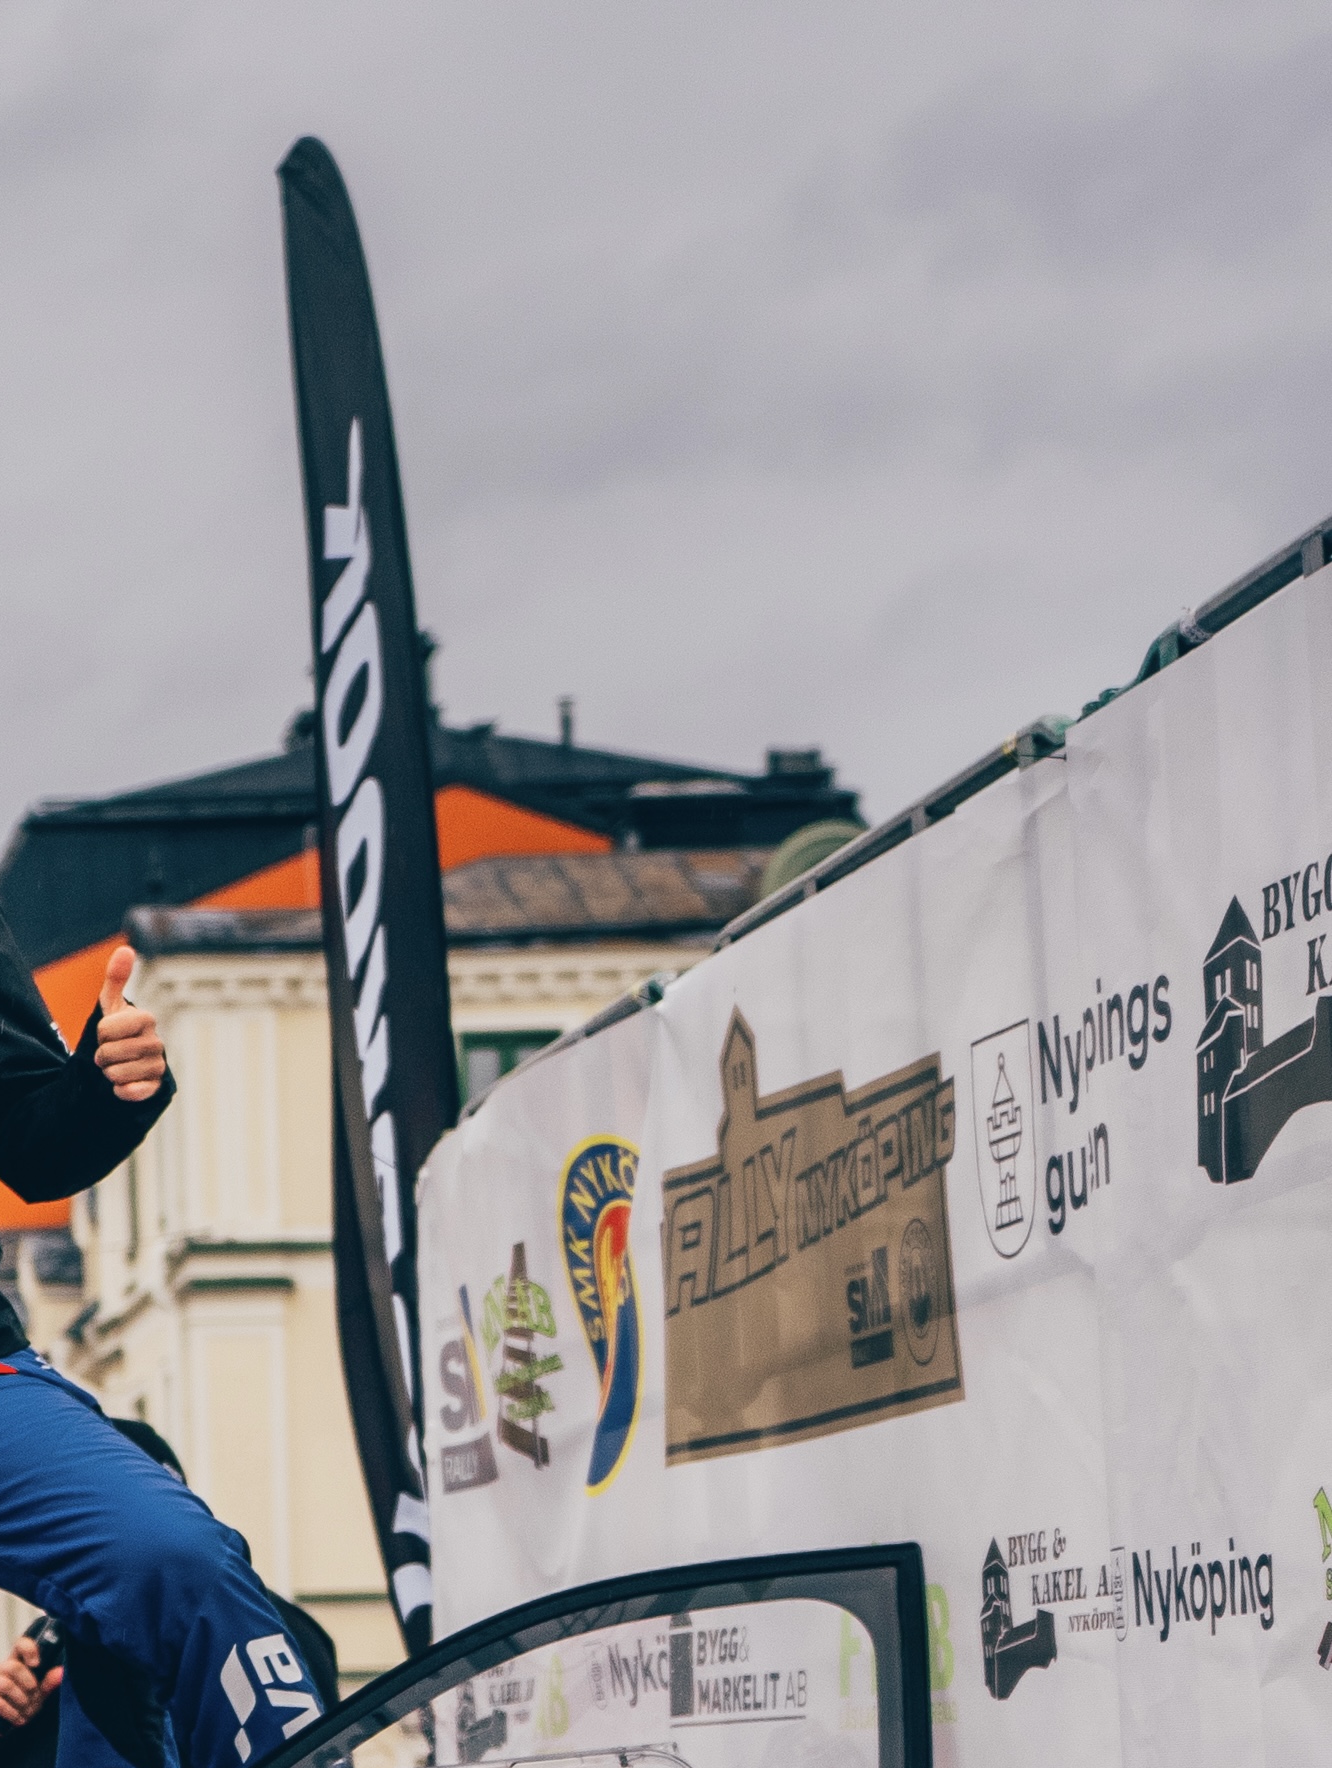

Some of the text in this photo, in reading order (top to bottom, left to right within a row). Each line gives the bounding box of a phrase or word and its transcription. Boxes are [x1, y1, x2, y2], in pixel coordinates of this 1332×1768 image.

[1008, 1528, 1067, 1568] BYGG &
[1031, 1567, 1087, 1606] KAKEL
[1132, 1537, 1274, 1642] Nyköping
[696, 1672, 781, 1714] MARKELIT
